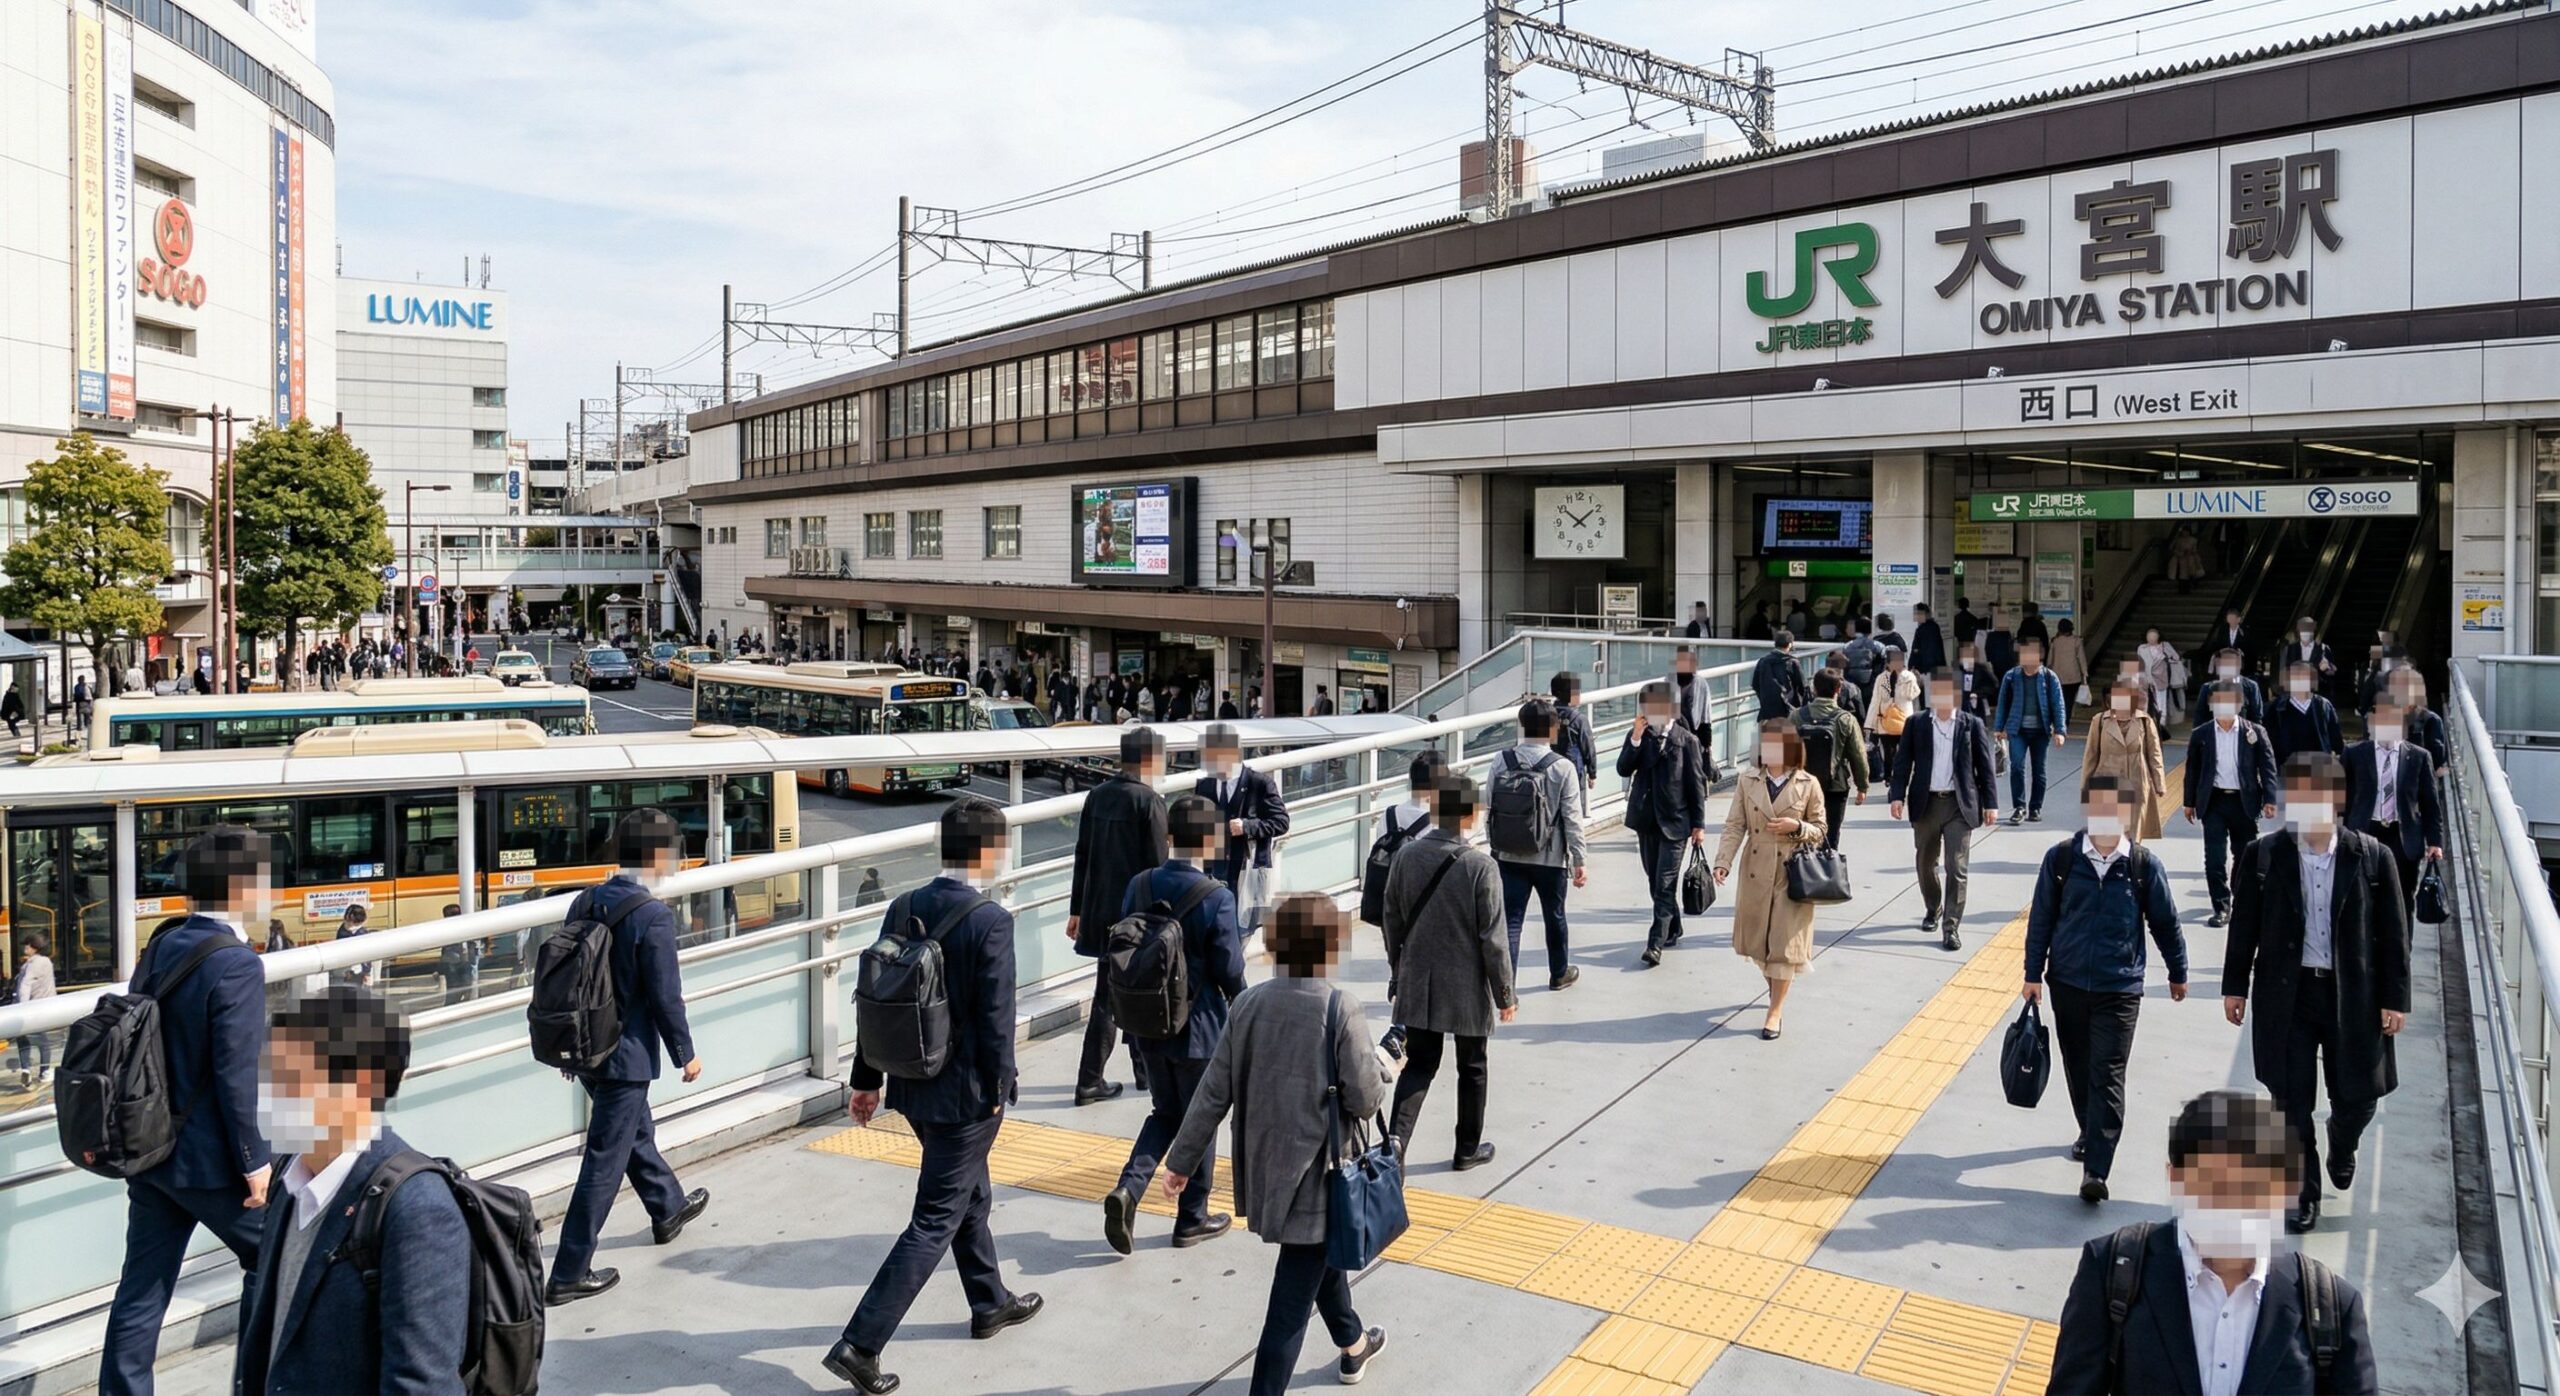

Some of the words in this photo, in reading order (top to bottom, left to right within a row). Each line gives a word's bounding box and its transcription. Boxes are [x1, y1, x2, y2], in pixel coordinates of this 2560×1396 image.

[1934, 148, 2344, 299] 大宮駅
[137, 257, 207, 308] SOGO
[1746, 222, 1881, 319] JR
[368, 293, 494, 330] LUMINE
[1979, 293, 2105, 336] OMIYA
[2118, 270, 2308, 323] STATION
[1755, 316, 1874, 354] JR東日本
[2020, 384, 2098, 422] 西口
[2113, 393, 2181, 417] (West
[2190, 388, 2238, 411] Exit
[1595, 504, 1602, 513] 2
[1992, 495, 2020, 512] JR
[2167, 490, 2267, 514] LUMINE
[2339, 490, 2392, 504] SOGO
[1556, 518, 1562, 527] 9
[1595, 530, 1602, 539] 4
[1598, 517, 1605, 526] 3
